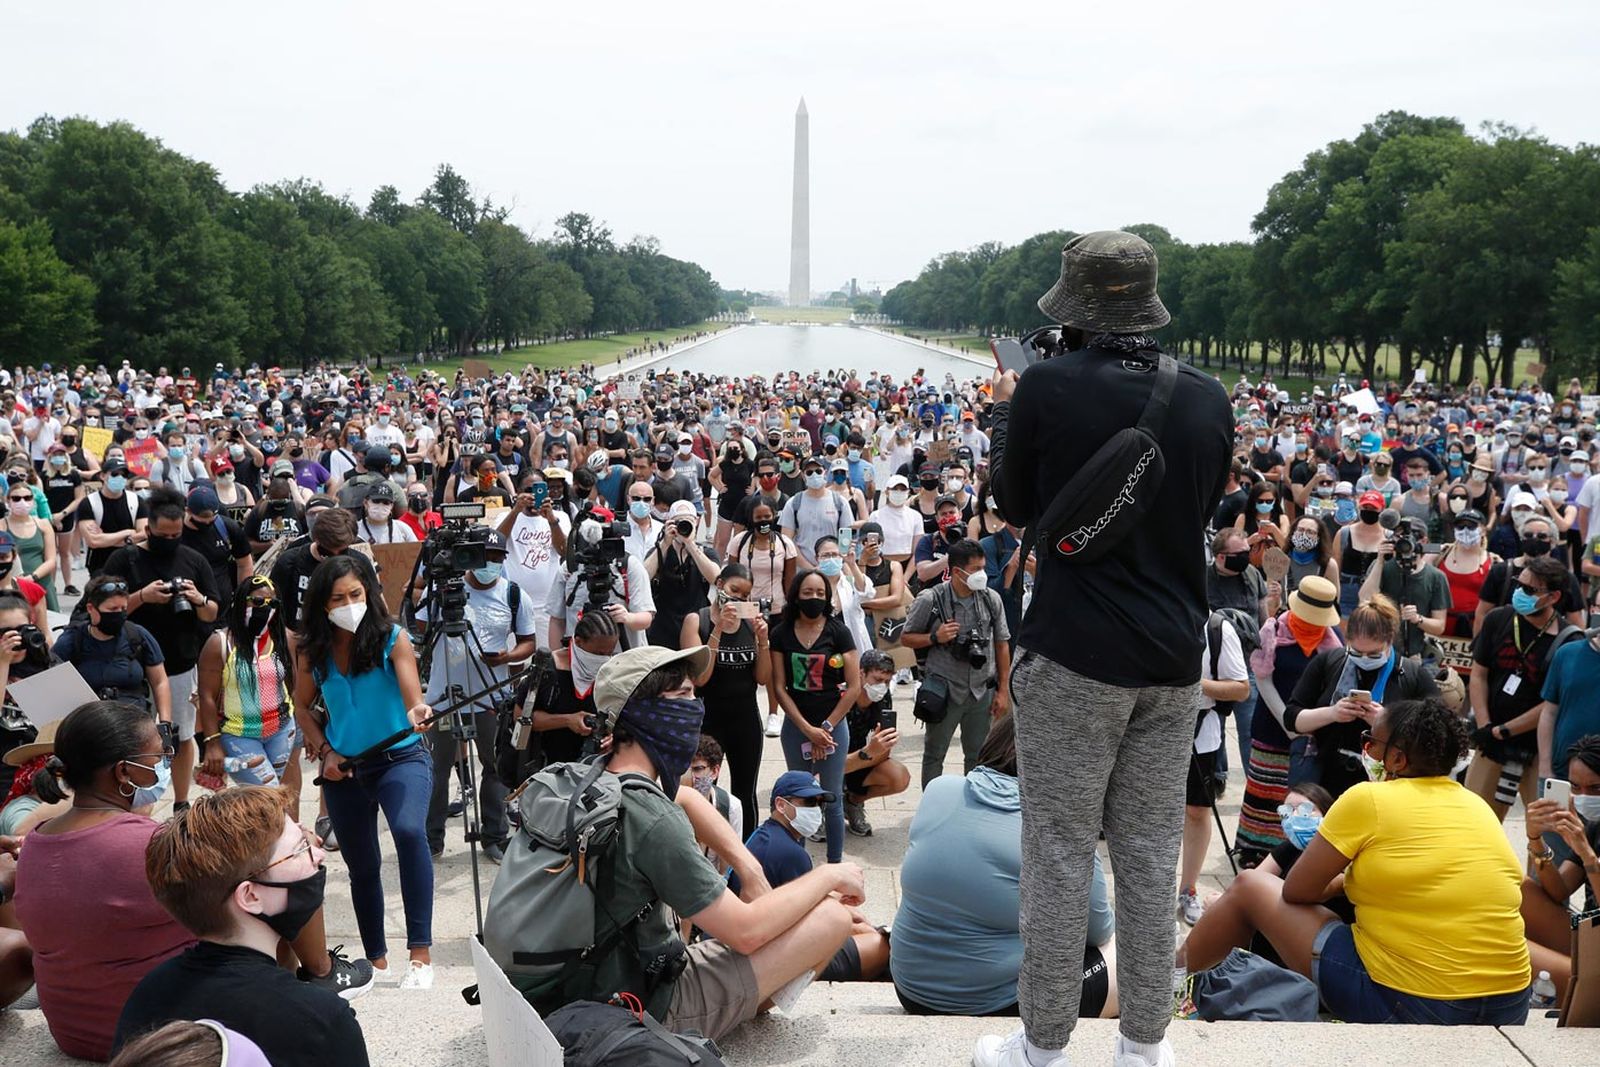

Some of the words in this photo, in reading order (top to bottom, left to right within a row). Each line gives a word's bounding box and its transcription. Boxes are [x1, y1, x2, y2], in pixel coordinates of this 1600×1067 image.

[1056, 447, 1156, 556] Champion
[515, 526, 552, 546] Living
[520, 549, 550, 571] Life
[720, 652, 755, 662] LUX
